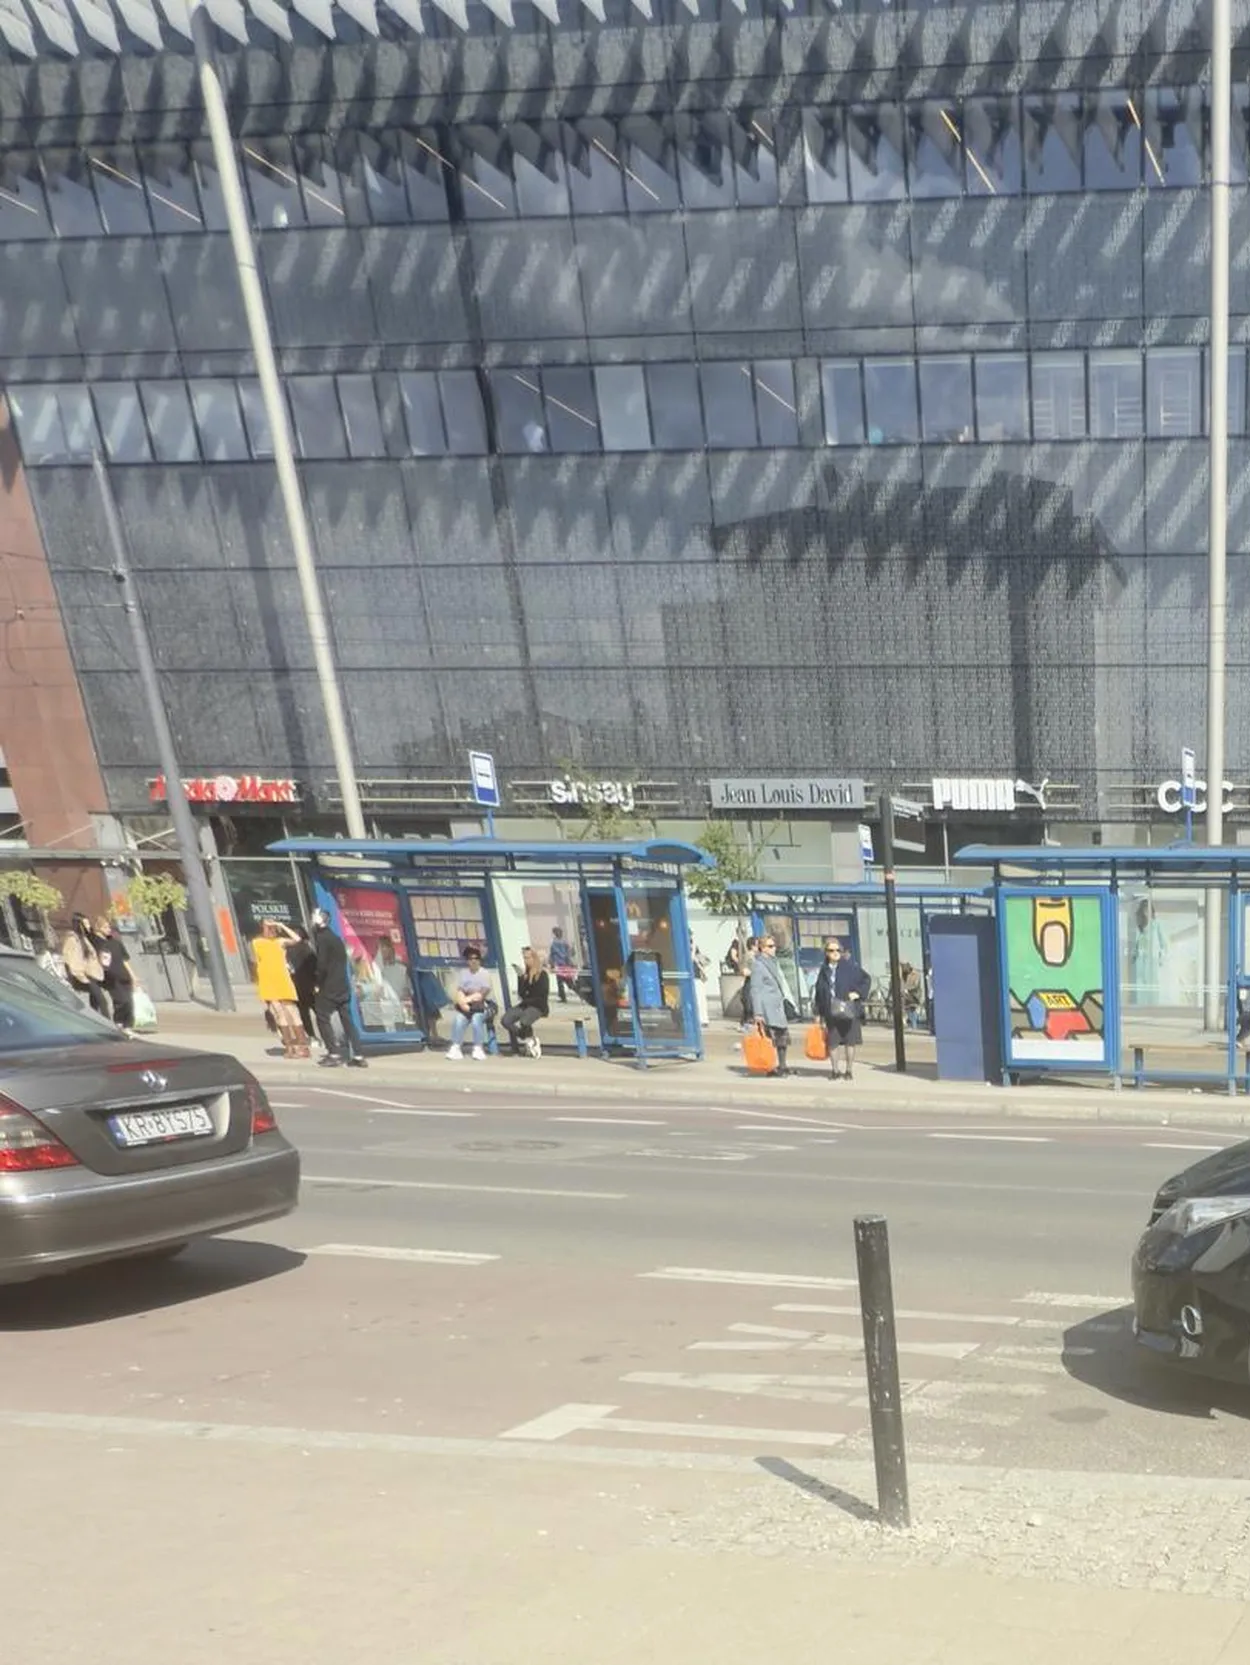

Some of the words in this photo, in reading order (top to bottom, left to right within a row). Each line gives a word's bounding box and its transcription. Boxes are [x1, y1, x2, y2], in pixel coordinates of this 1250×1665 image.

[551, 774, 634, 813] sinsay
[721, 783, 756, 805] Jean
[761, 783, 804, 805] Louis
[809, 783, 854, 805] David
[932, 778, 1016, 811] PUMA
[122, 1114, 149, 1138] KR
